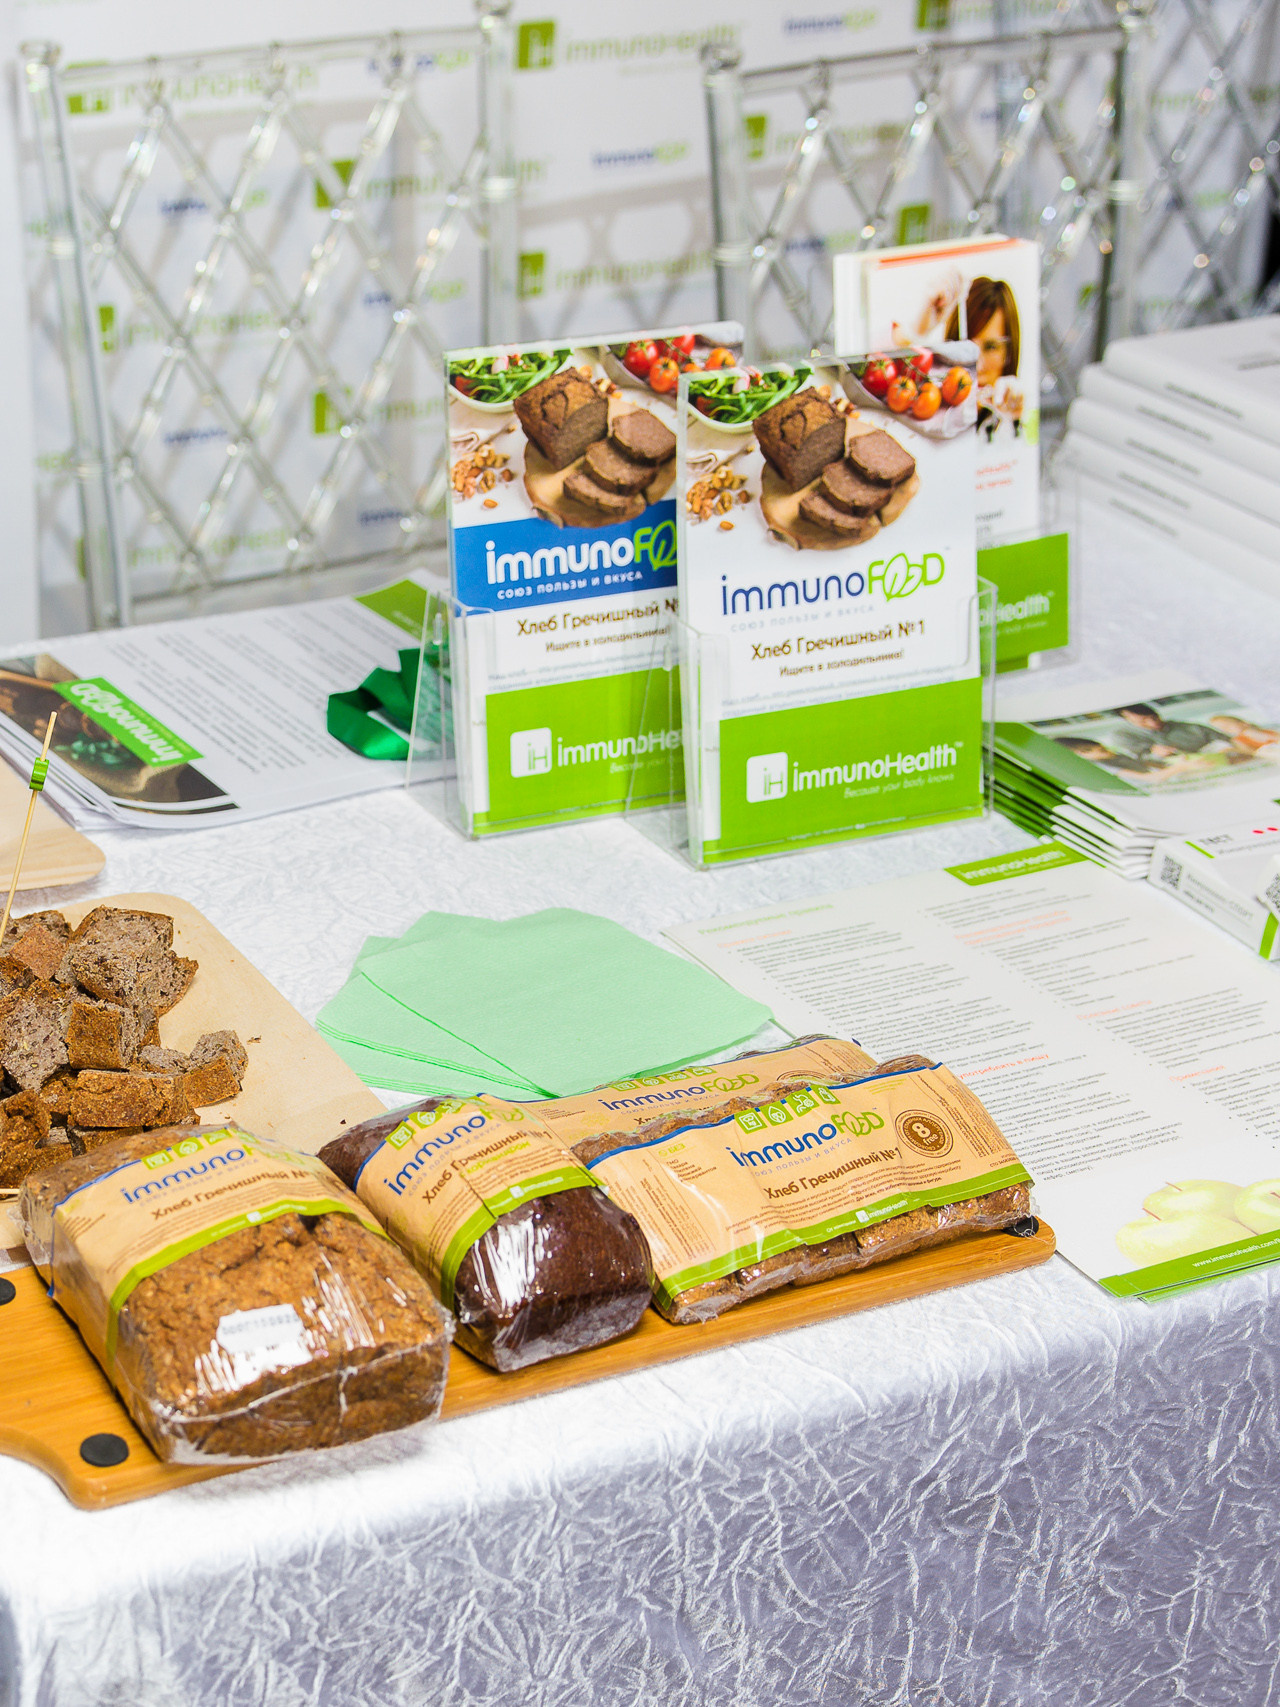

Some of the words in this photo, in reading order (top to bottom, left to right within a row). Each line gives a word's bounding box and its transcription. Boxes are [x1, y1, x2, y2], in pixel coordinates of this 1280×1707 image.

[497, 586, 533, 600] СОЮЗ
[537, 577, 588, 595] ПОЛЬЗЫ
[591, 576, 600, 587] И
[604, 571, 643, 586] ВКУСА
[517, 614, 558, 637] Хлеб
[563, 599, 660, 630] Гречишный
[751, 639, 793, 662] Хлеб
[797, 626, 893, 654] Гречишный
[557, 728, 685, 768] immunoHe
[912, 1122, 931, 1138] 8
[422, 1168, 453, 1205] Хлеб
[763, 1180, 800, 1200] Хлеб
[798, 1151, 882, 1191] Гречишный
[151, 1198, 192, 1221] Хлеб
[194, 1169, 289, 1203] Гречишный
